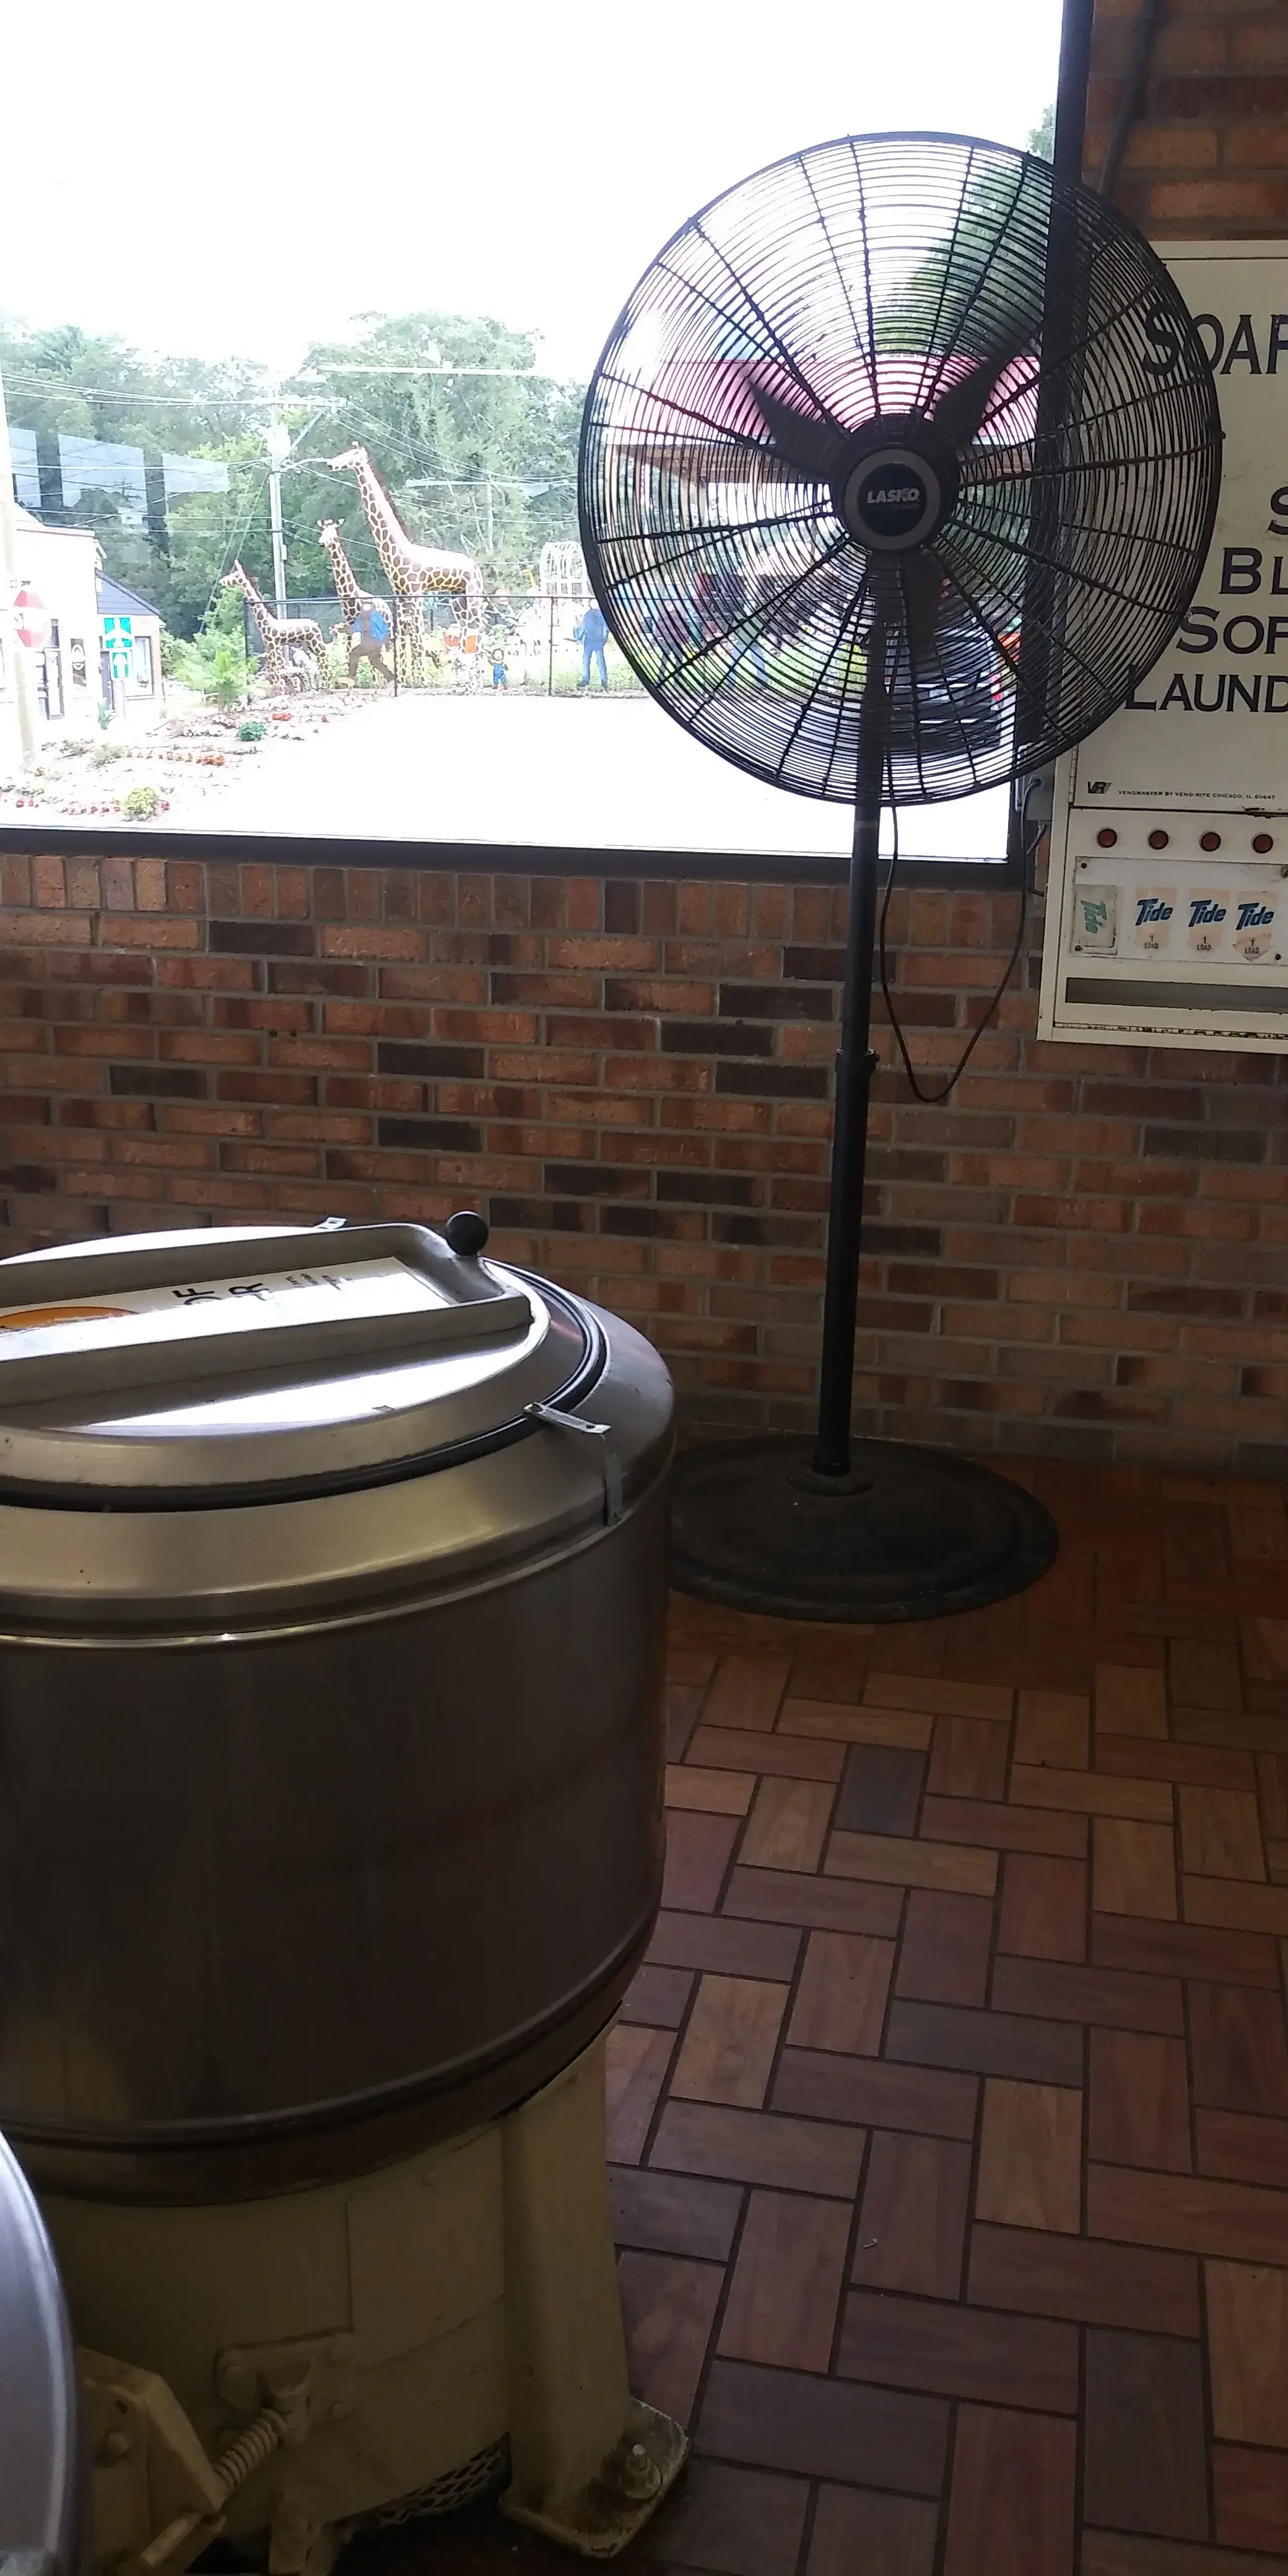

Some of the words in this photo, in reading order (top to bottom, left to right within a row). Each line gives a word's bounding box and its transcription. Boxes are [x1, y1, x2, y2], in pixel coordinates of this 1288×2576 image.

[866, 488, 920, 503] LASKO
[1080, 900, 1107, 934] Tide
[1135, 898, 1173, 926] Tide
[1188, 900, 1227, 928] Tide
[1235, 902, 1275, 931] Tide
[1150, 934, 1154, 942] 1
[1203, 936, 1207, 944] 1
